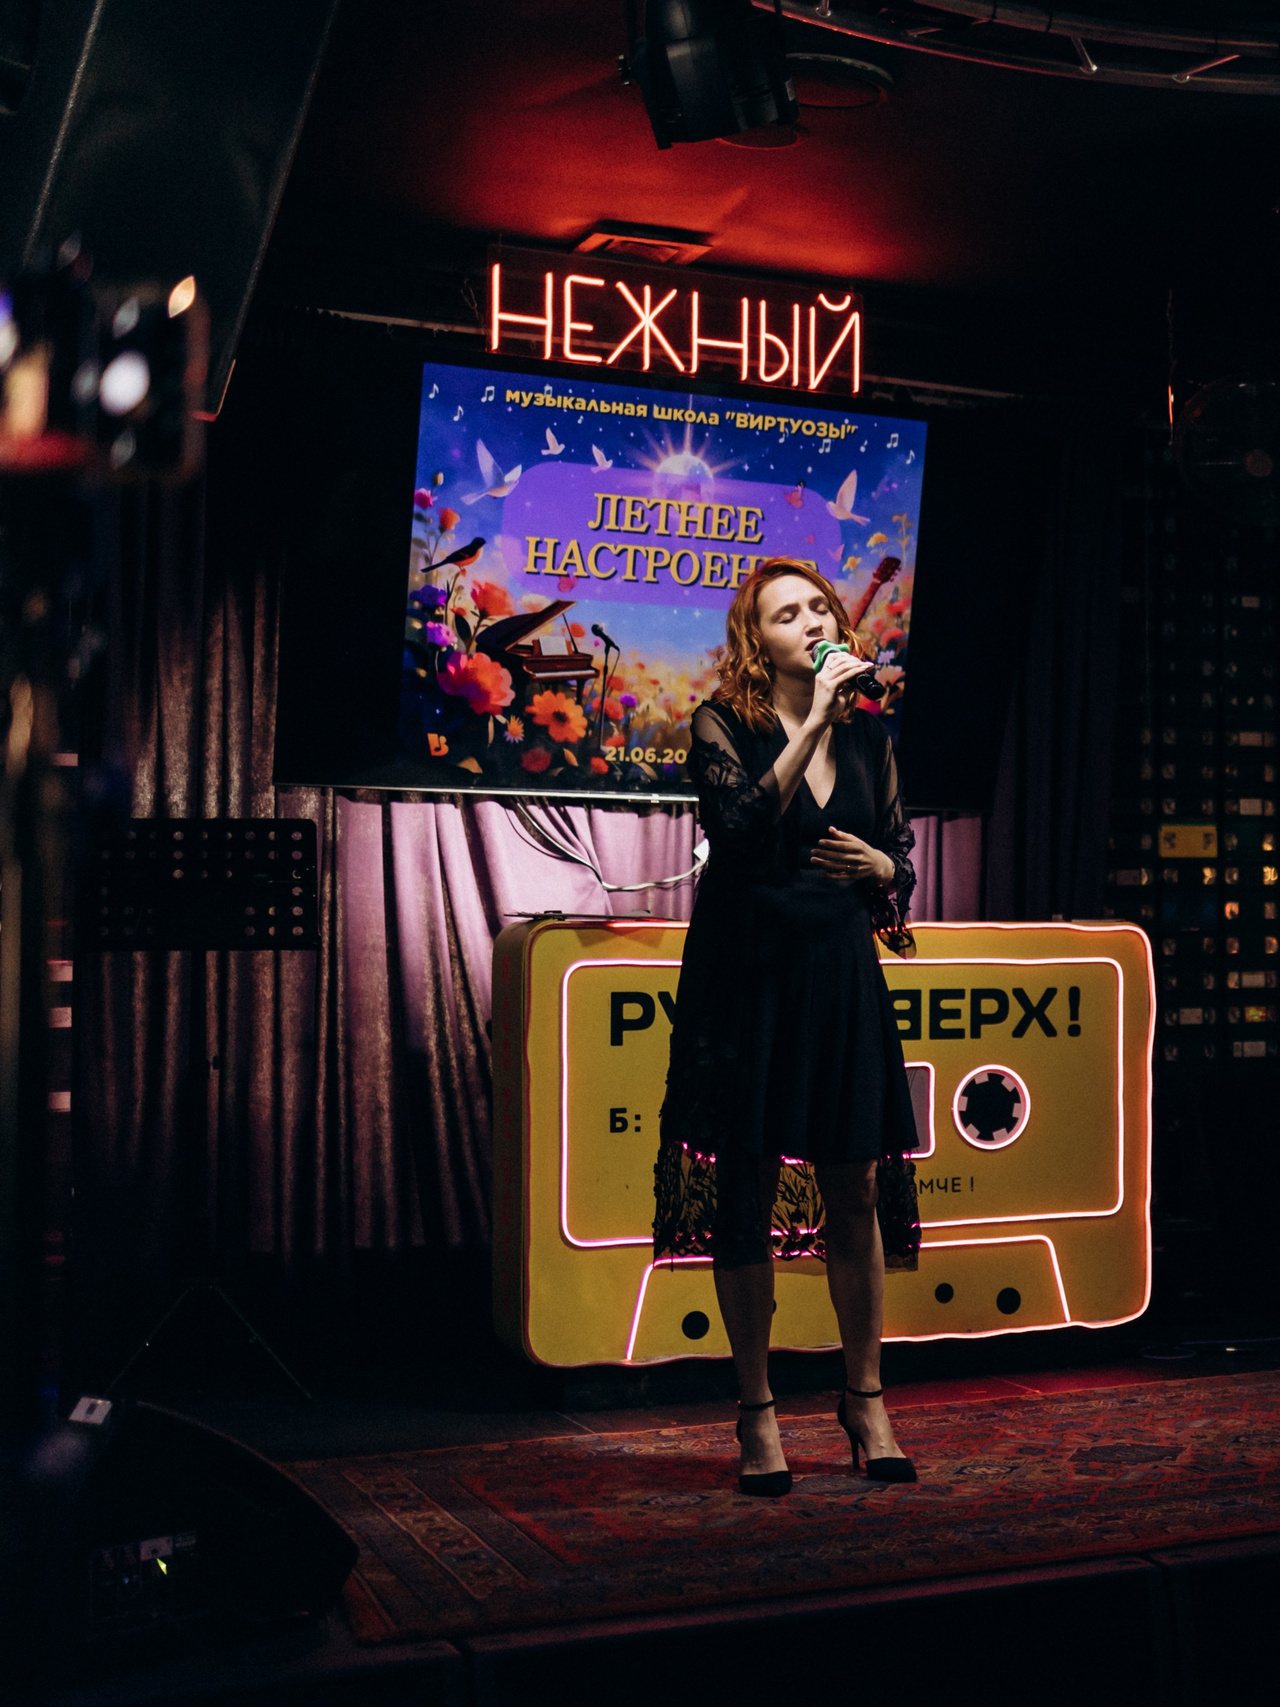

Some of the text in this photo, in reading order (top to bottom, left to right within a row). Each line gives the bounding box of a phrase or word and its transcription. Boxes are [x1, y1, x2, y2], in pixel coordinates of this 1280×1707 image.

[490, 263, 860, 394] НЕЖНЫЙ
[505, 389, 857, 440] музыкальная школа "ВИРТУОЗЫ"
[588, 492, 764, 544] ЛЕТНЕЕ
[523, 535, 819, 590] НАСТРОЕН
